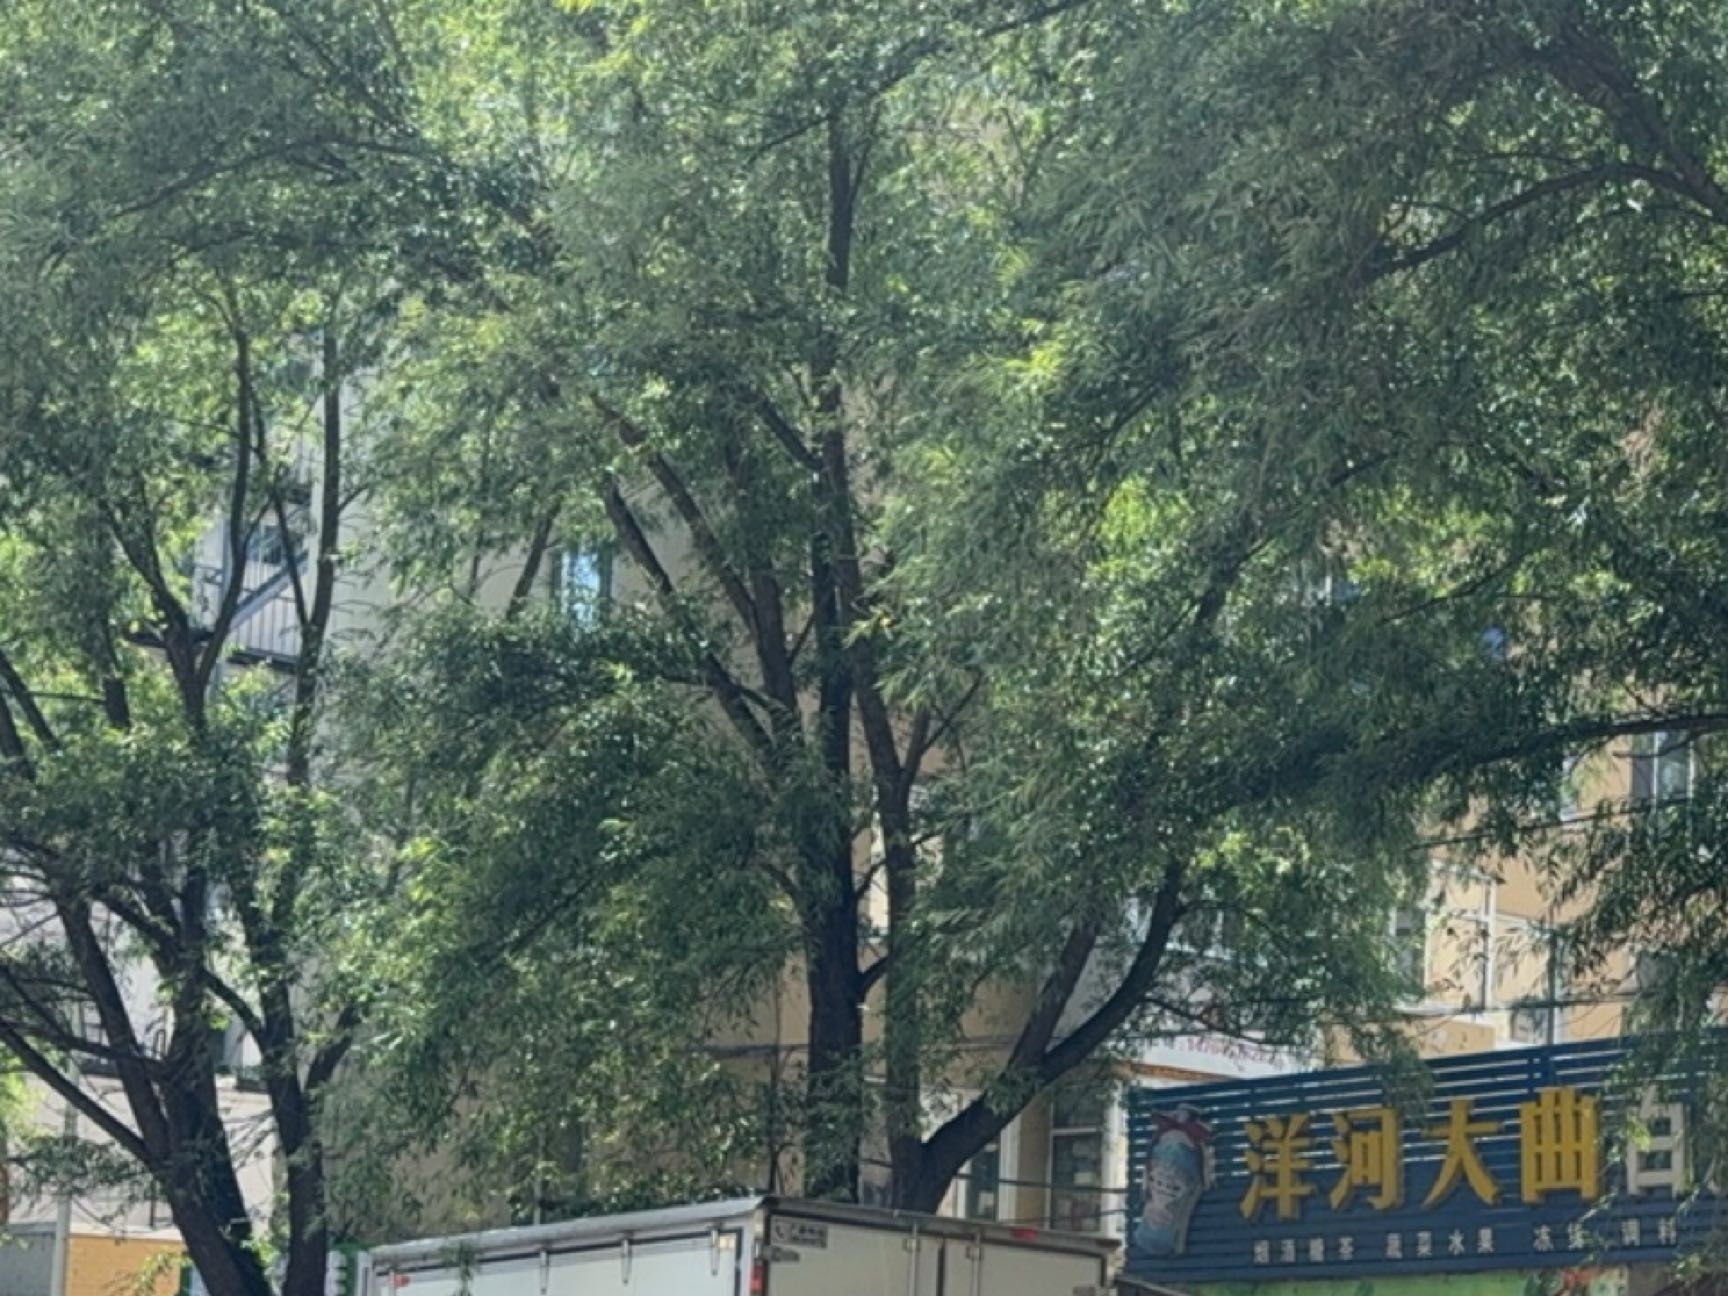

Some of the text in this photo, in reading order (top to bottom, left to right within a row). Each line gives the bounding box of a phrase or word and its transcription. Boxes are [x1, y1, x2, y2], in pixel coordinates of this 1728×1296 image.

[1240, 1087, 1600, 1220] 洋河大曲
[1387, 1226, 1494, 1259] 蔬菜水果
